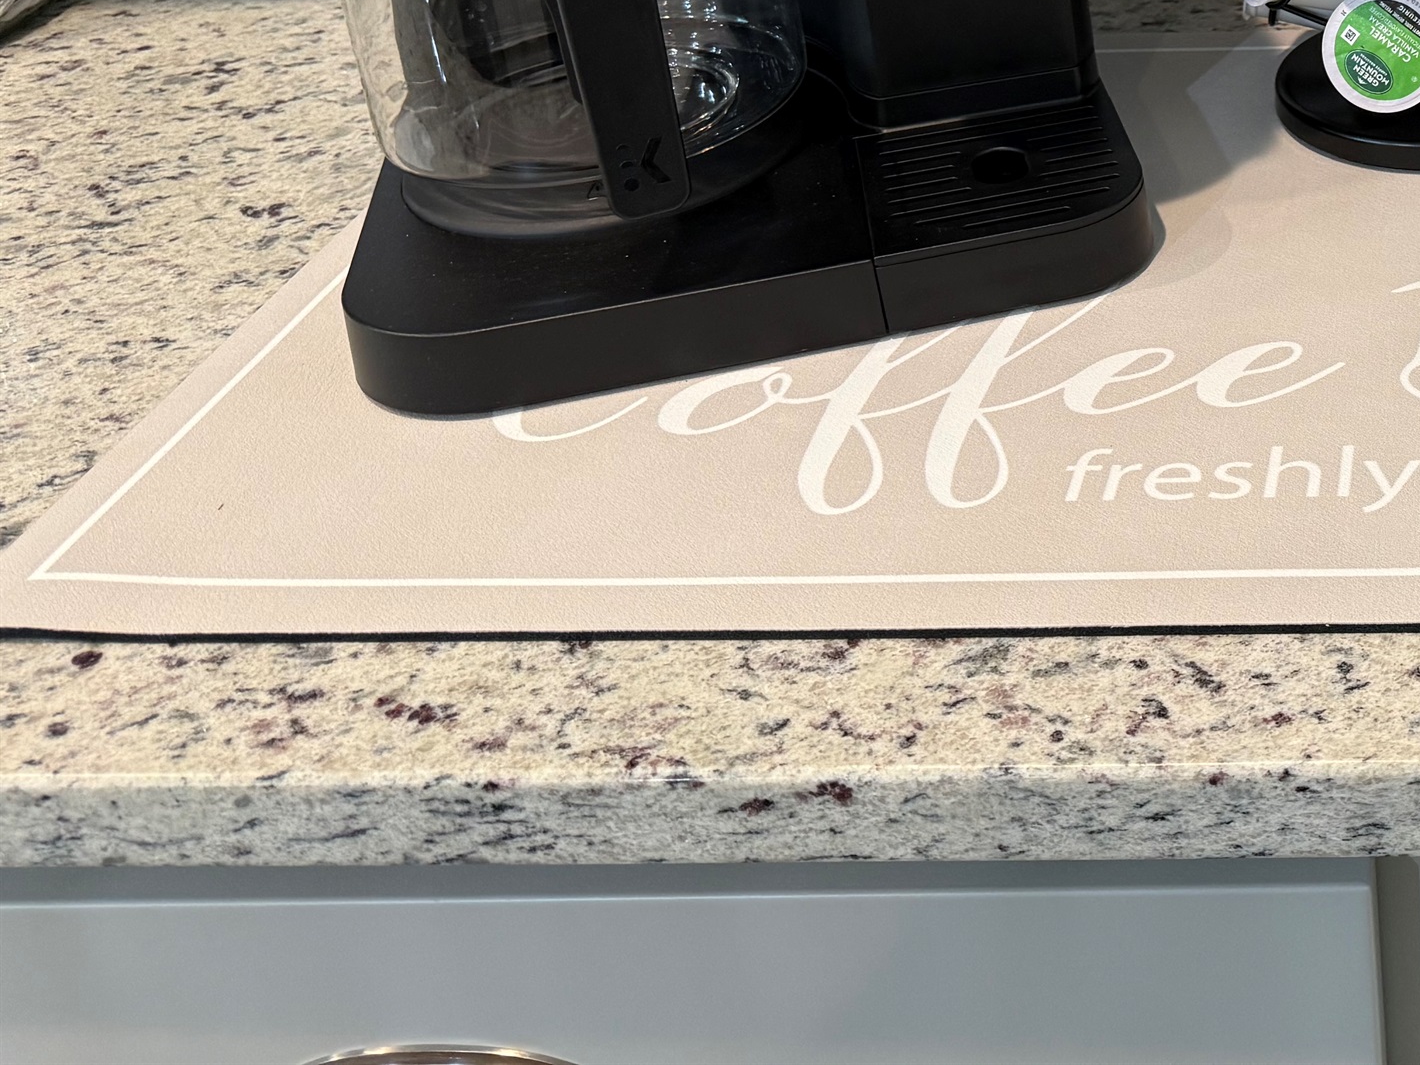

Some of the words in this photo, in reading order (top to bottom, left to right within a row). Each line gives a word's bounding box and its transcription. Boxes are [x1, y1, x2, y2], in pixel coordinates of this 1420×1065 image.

[1368, 14, 1393, 36] CREAM
[1366, 25, 1411, 62] CARAMEL
[1392, 33, 1420, 58] VANILLA
[1350, 53, 1389, 85] MOUNTAIN
[1352, 64, 1379, 87] GREEN
[492, 294, 1346, 515] offee
[1065, 443, 1420, 513] freshly
